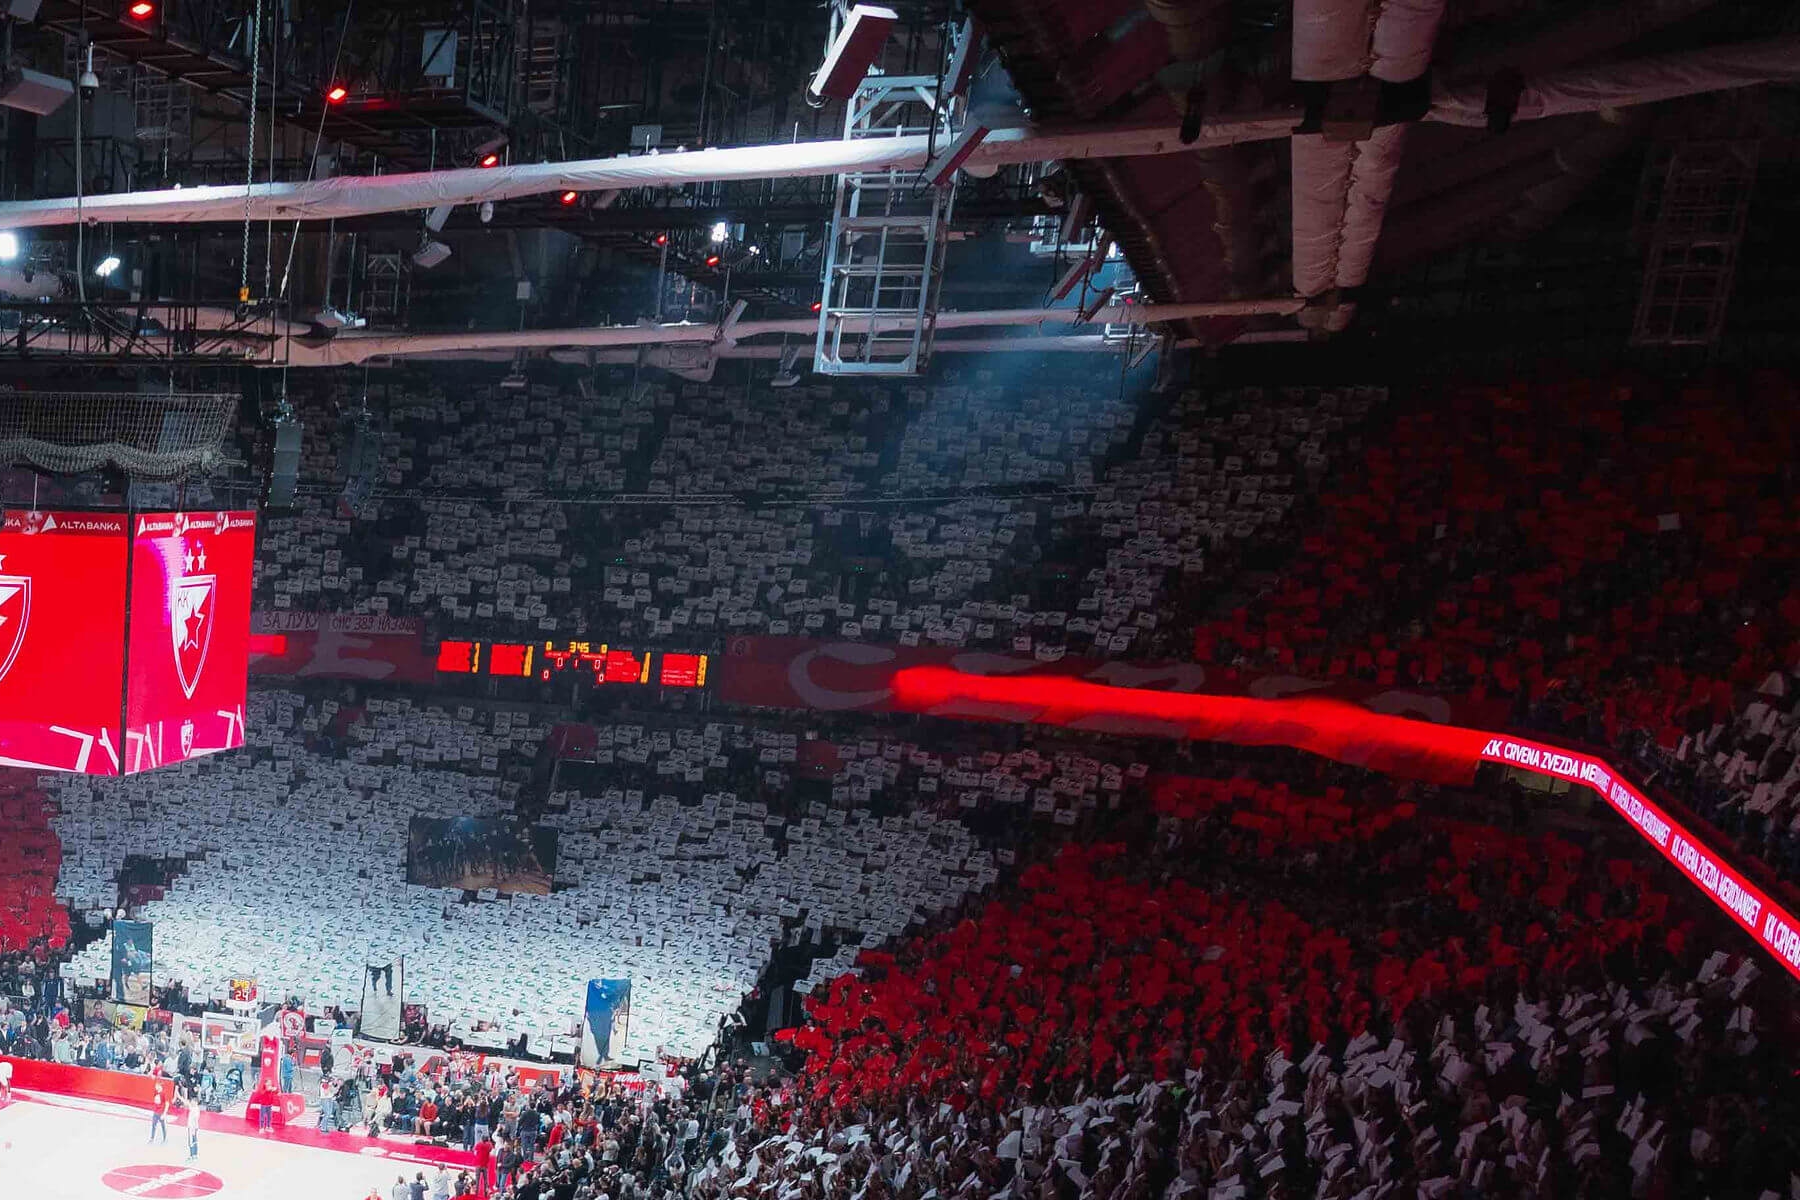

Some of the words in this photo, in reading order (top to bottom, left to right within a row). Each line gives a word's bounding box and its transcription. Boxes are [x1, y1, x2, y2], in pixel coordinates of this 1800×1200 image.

[60, 521, 121, 532] ALTABANKA
[1503, 742, 1540, 767] CRVENA
[1539, 751, 1579, 778] ZVEZDA
[1774, 921, 1800, 971] CRVEN
